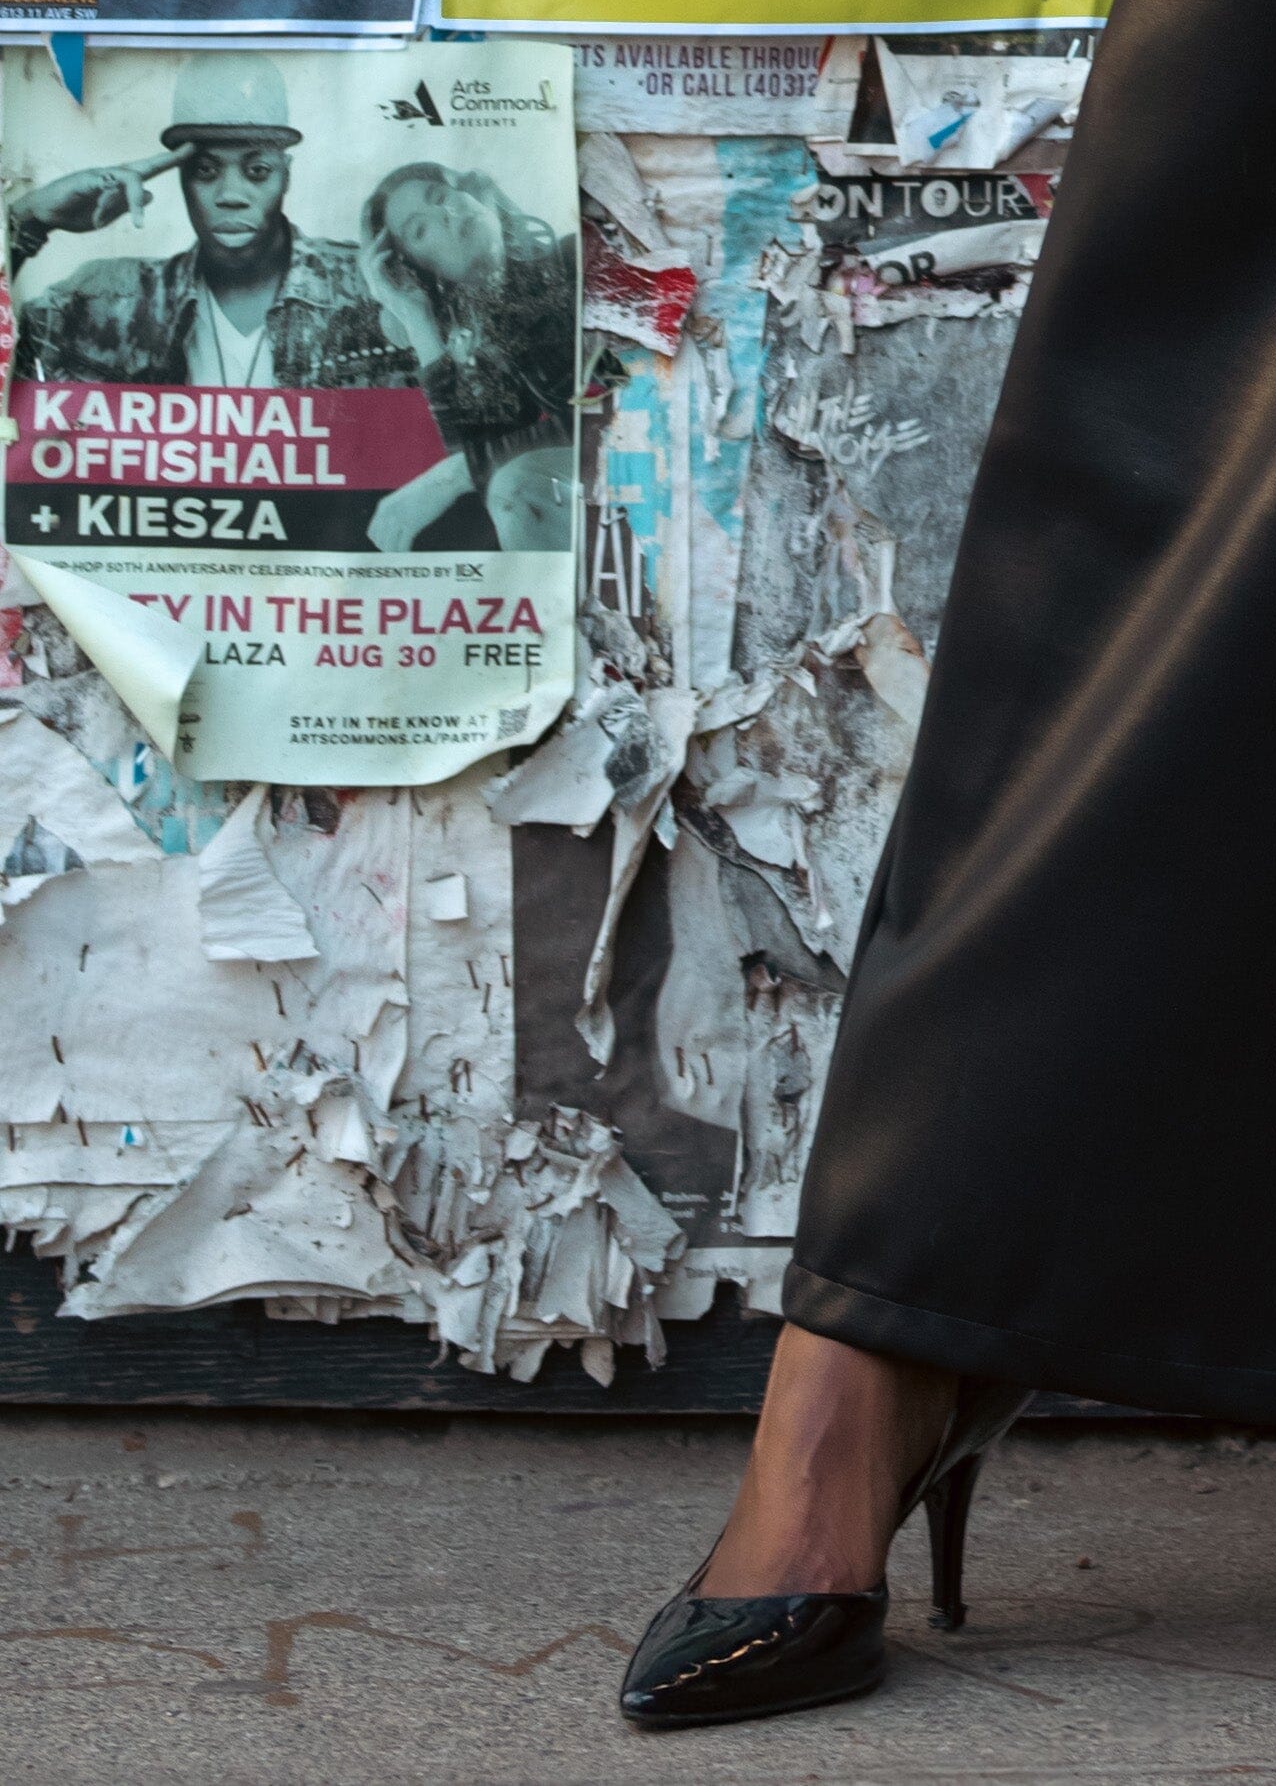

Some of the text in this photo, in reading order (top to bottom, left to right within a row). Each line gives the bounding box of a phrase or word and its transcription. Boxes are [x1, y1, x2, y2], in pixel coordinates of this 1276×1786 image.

[614, 45, 731, 69] AVAILABLE
[450, 95, 547, 112] Commons
[812, 180, 1027, 218] ON TOUR
[34, 390, 330, 437] KARDINAL
[31, 438, 345, 486] OFFISHALL
[77, 495, 287, 540] KIESZA
[146, 563, 428, 578] ANNIVERSARY CELEBRATION PRESENTED
[206, 596, 541, 635] IN THE PLAZA
[315, 644, 541, 667] AUG 30 FREE
[290, 732, 488, 745] ARTSCOMMONS.CA/PARTY
